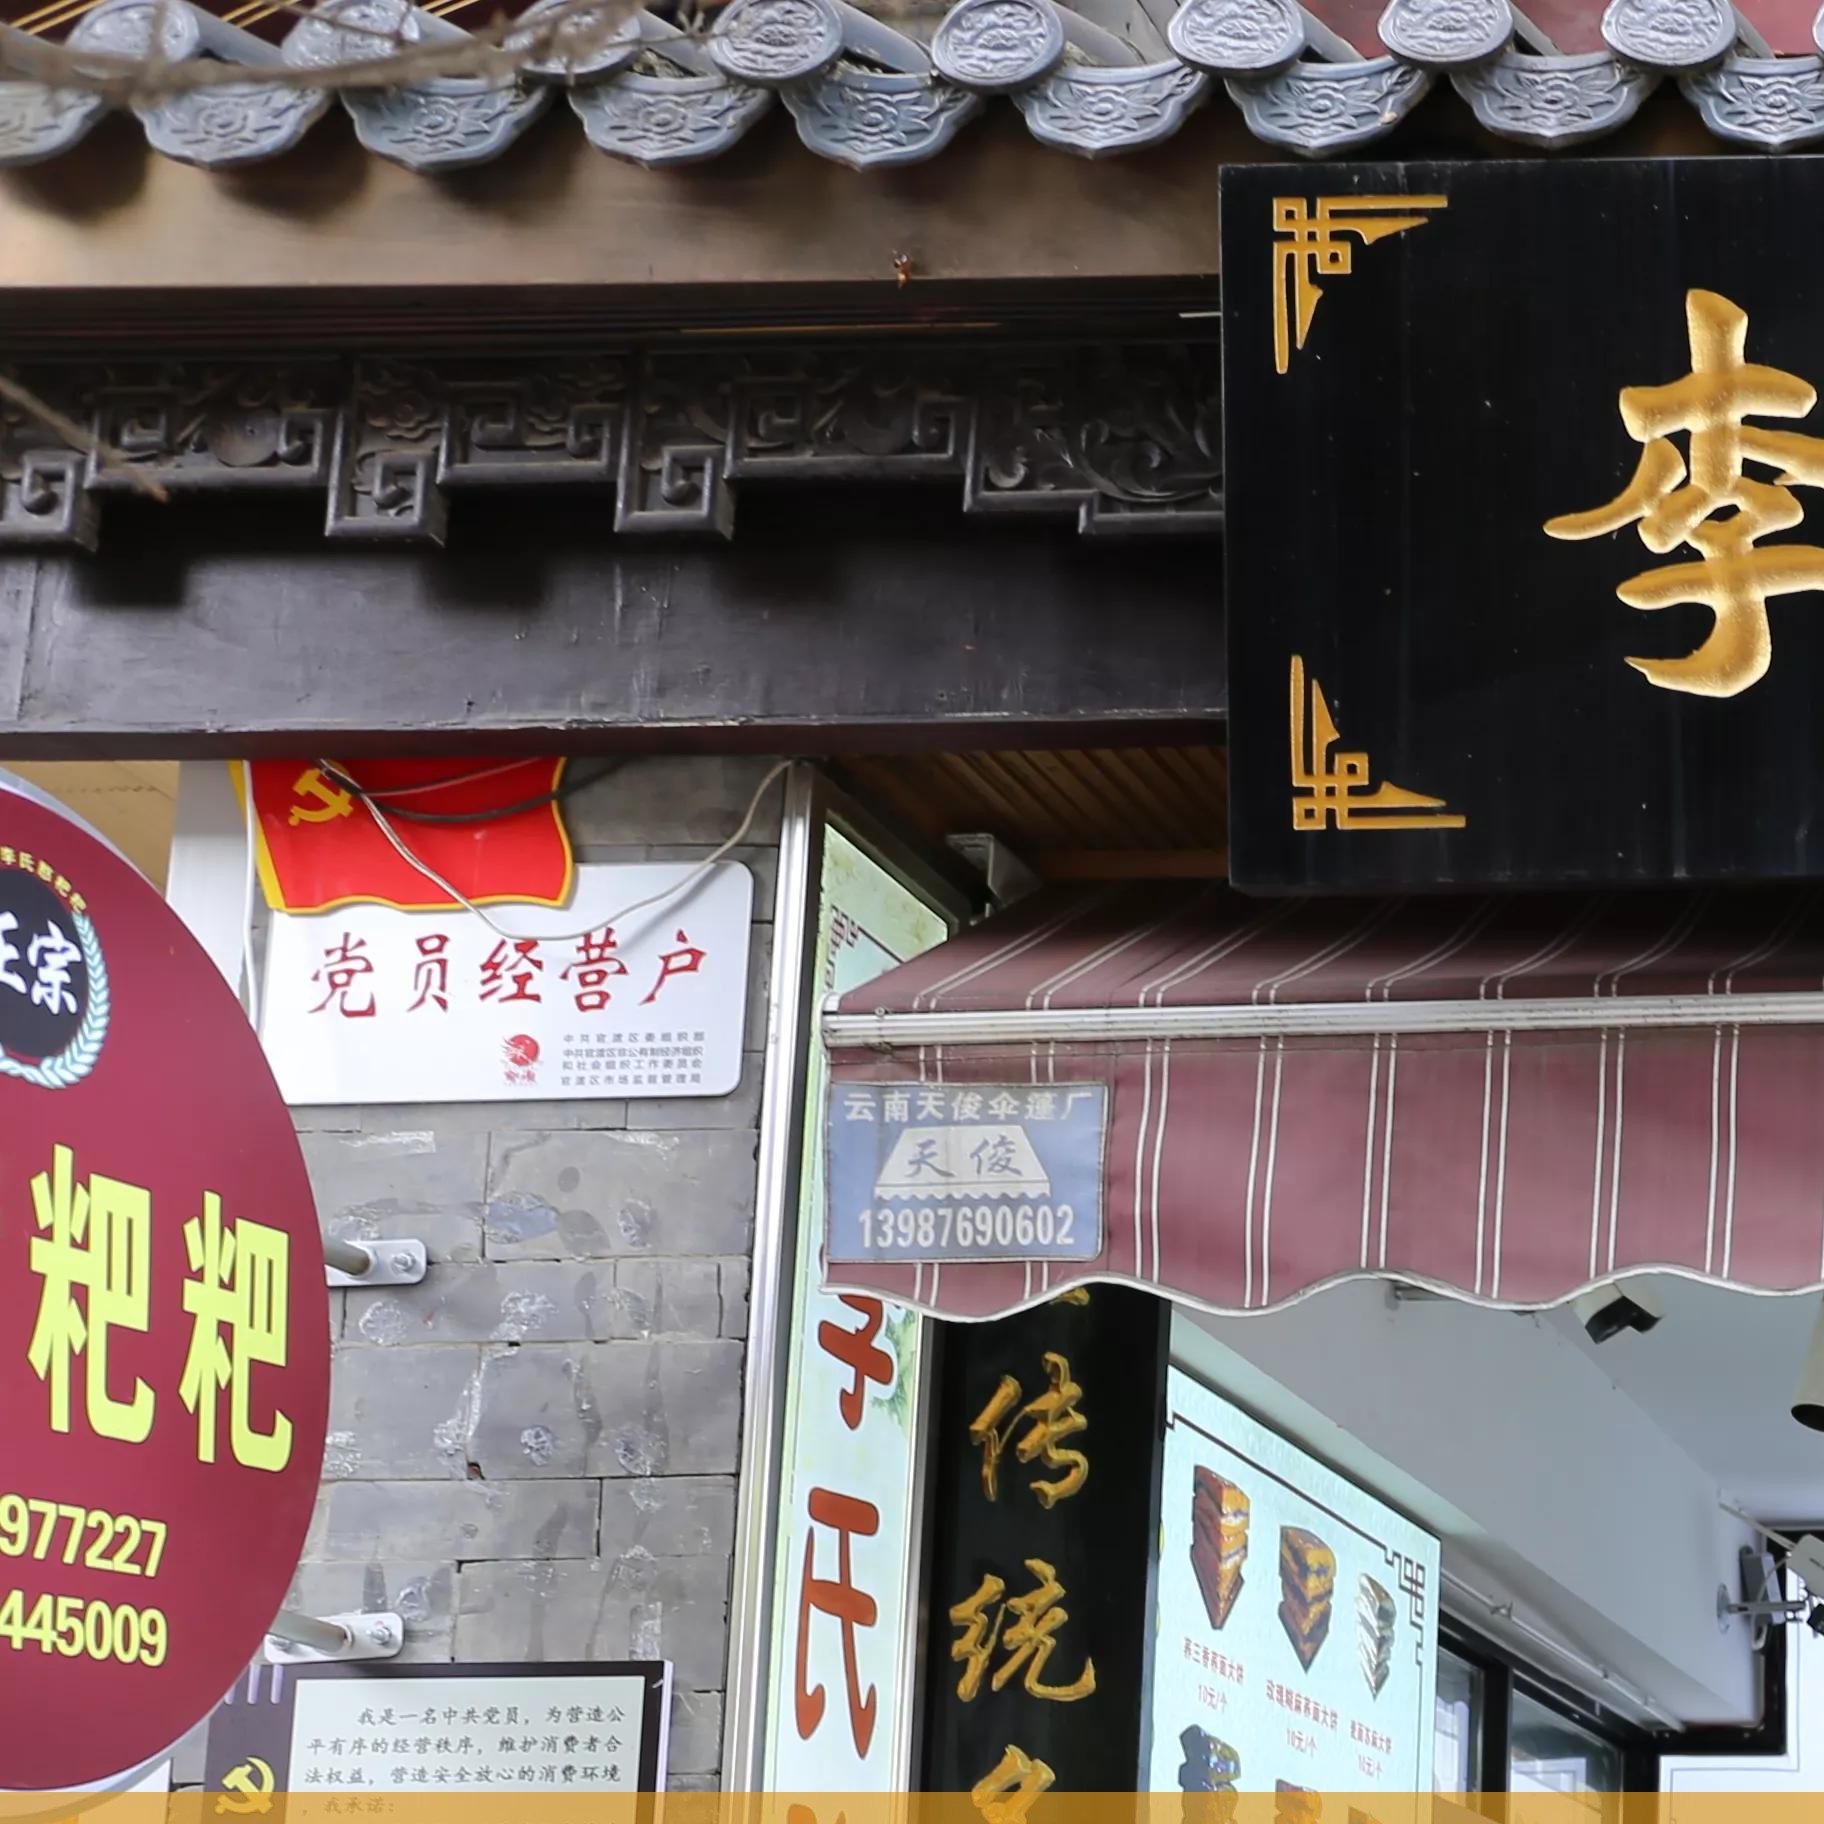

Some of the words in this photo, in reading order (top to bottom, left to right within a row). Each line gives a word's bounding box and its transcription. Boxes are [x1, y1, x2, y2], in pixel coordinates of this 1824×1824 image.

[309, 929, 707, 1018] 党员经营户
[907, 1135, 1024, 1178] 天俊
[859, 1204, 1075, 1248] 13987690602
[28, 1144, 293, 1472] 粑粑
[0, 1494, 167, 1577] 977227
[0, 1590, 168, 1667] 445009
